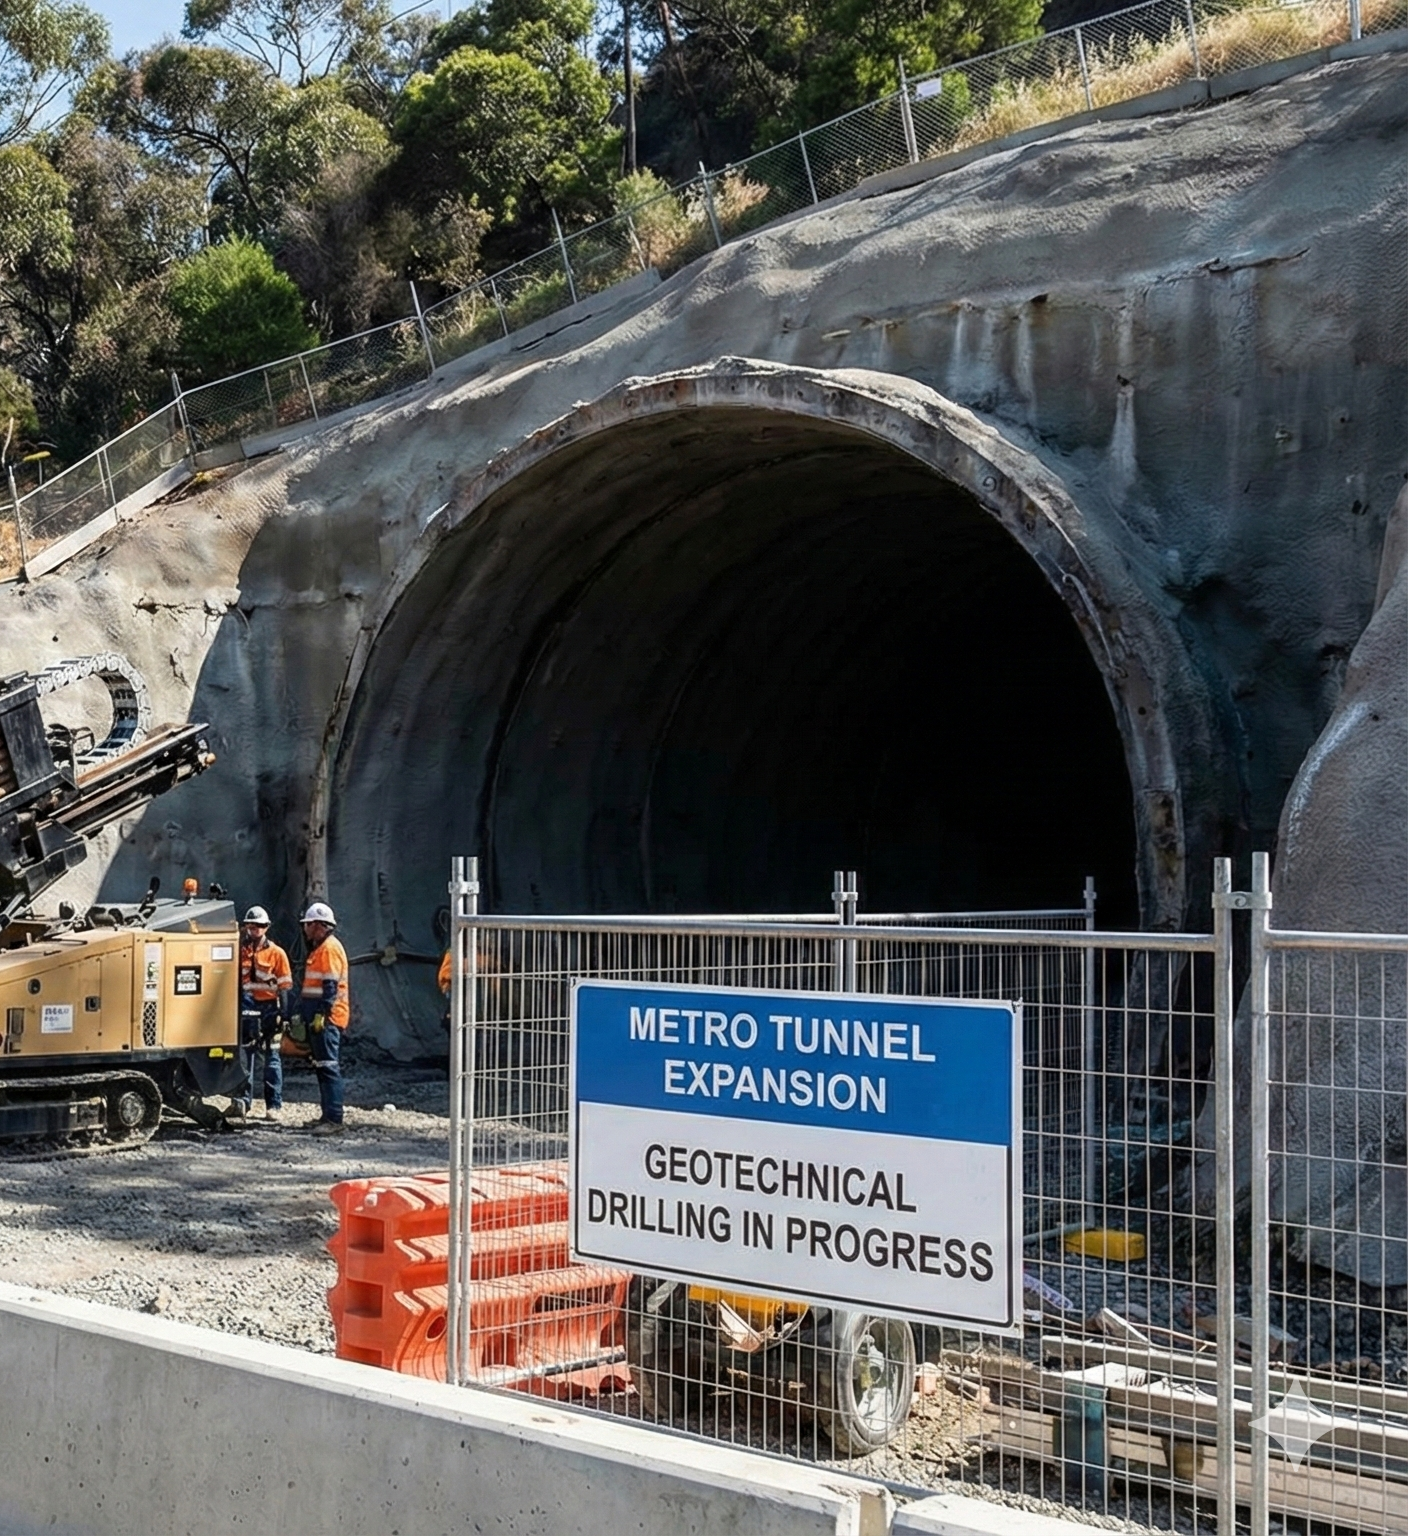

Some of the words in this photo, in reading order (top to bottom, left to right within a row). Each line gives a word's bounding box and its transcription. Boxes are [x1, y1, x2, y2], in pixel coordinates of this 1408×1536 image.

[629, 1006, 758, 1050] METRO
[769, 1014, 936, 1063] TUNNEL
[664, 1058, 887, 1114] EXPANSION
[645, 1143, 917, 1213] GEOTECHNICAL
[588, 1188, 731, 1243] DRILLING
[743, 1210, 773, 1250] IN
[786, 1216, 994, 1282] PROGRESS
